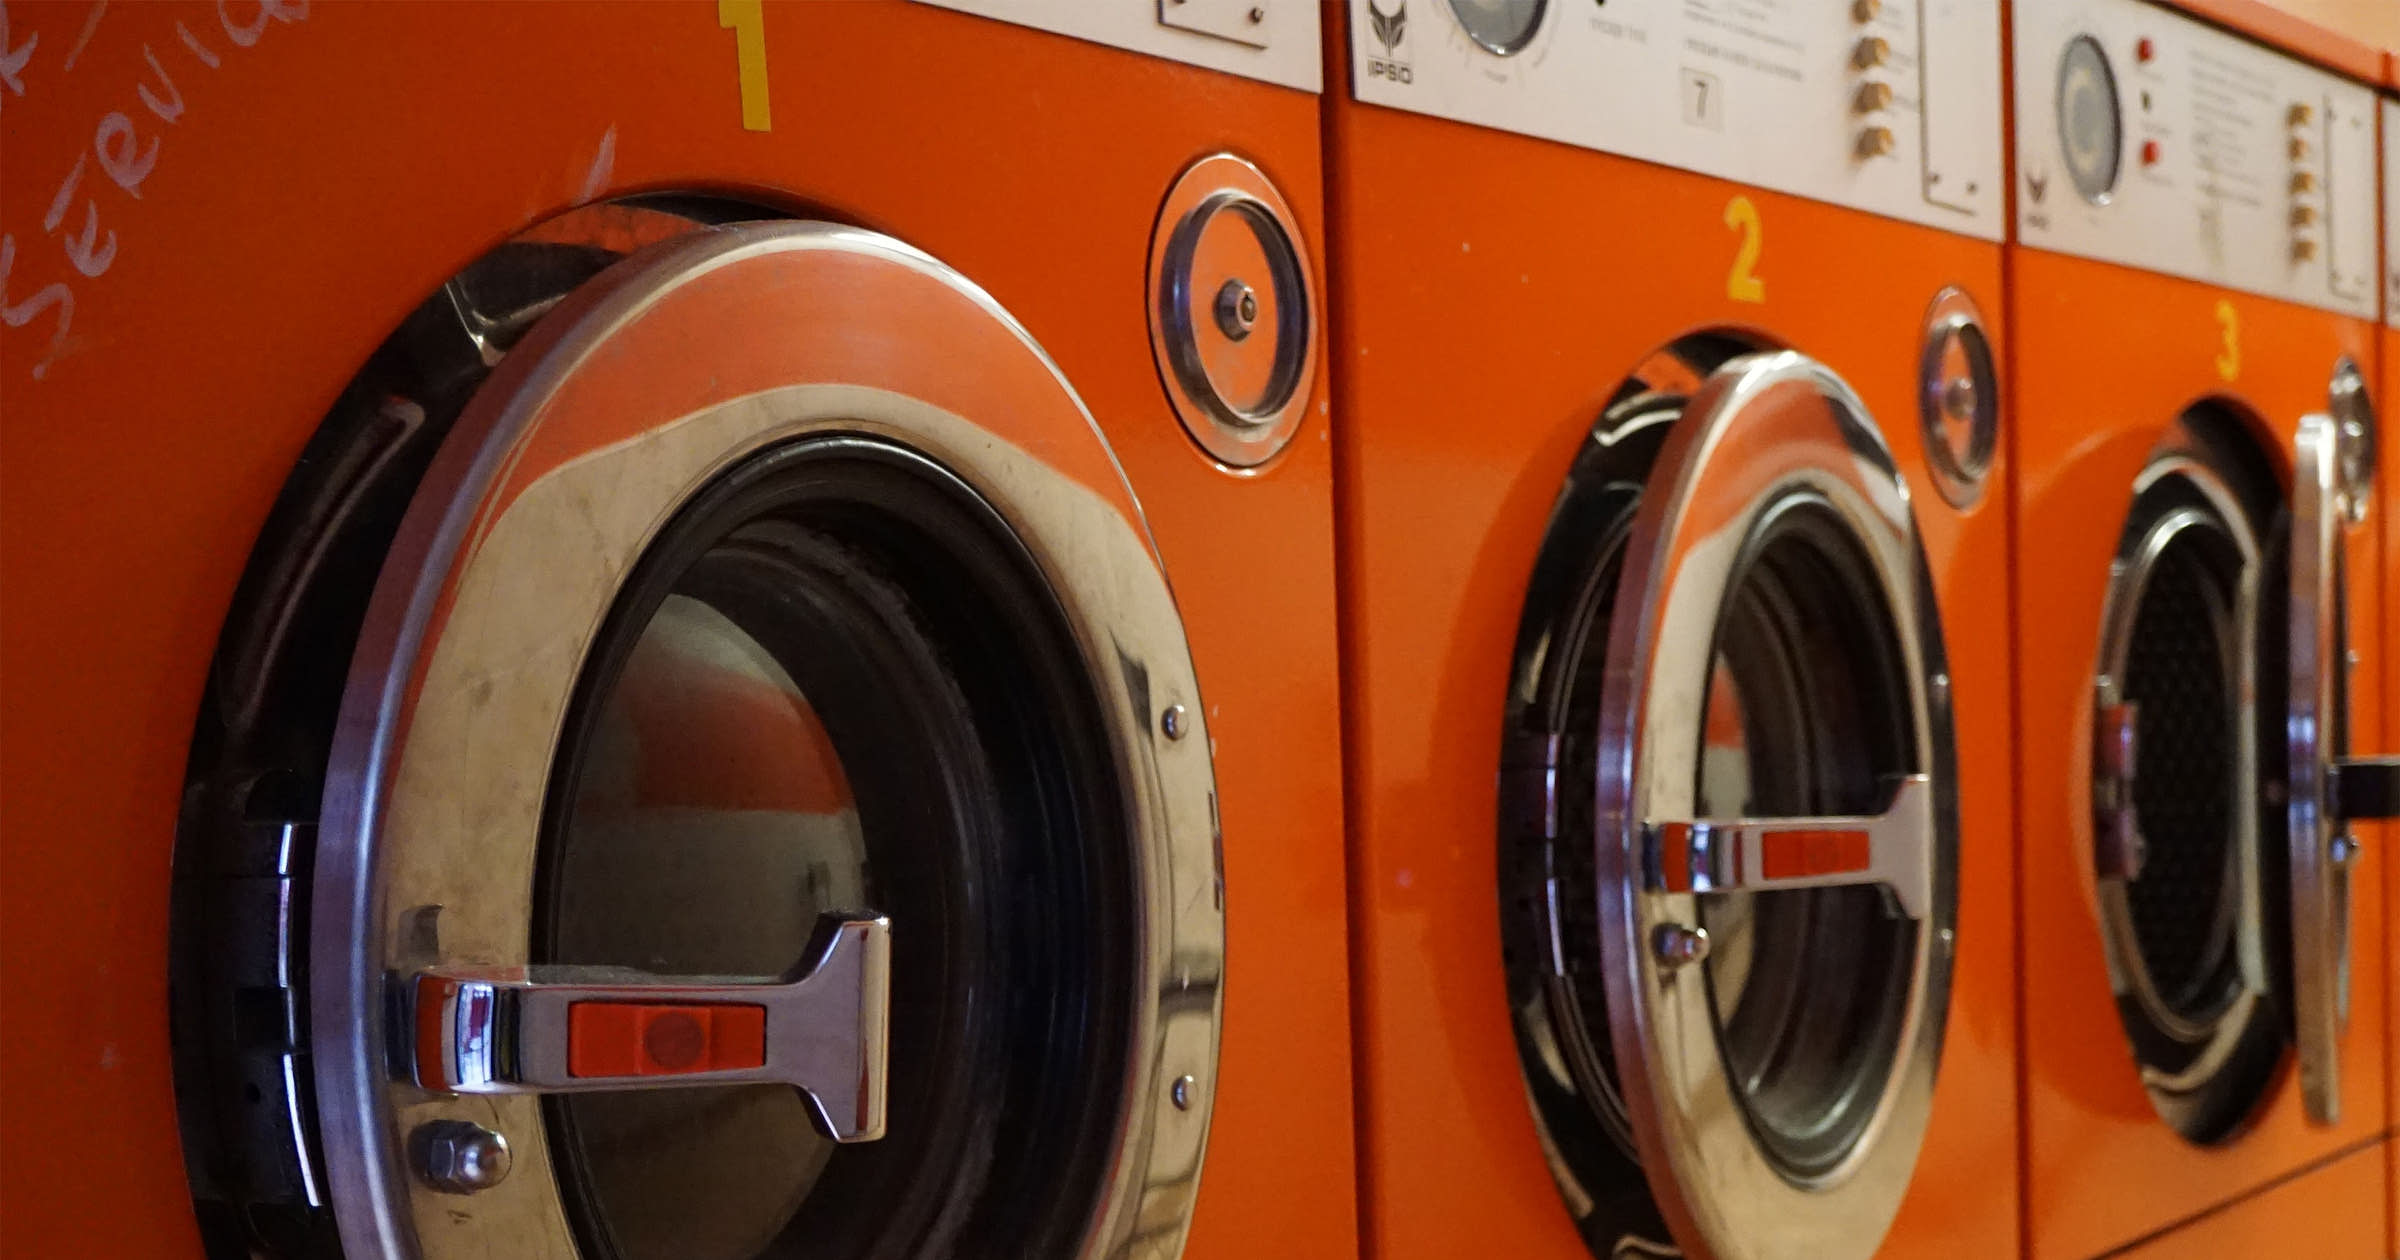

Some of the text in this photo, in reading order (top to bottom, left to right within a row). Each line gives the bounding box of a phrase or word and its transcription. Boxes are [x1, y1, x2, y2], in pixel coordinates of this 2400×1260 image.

[717, 0, 772, 133] 1
[1367, 58, 1413, 85] IPSO
[1723, 195, 1765, 303] 2
[2215, 299, 2241, 381] 3
